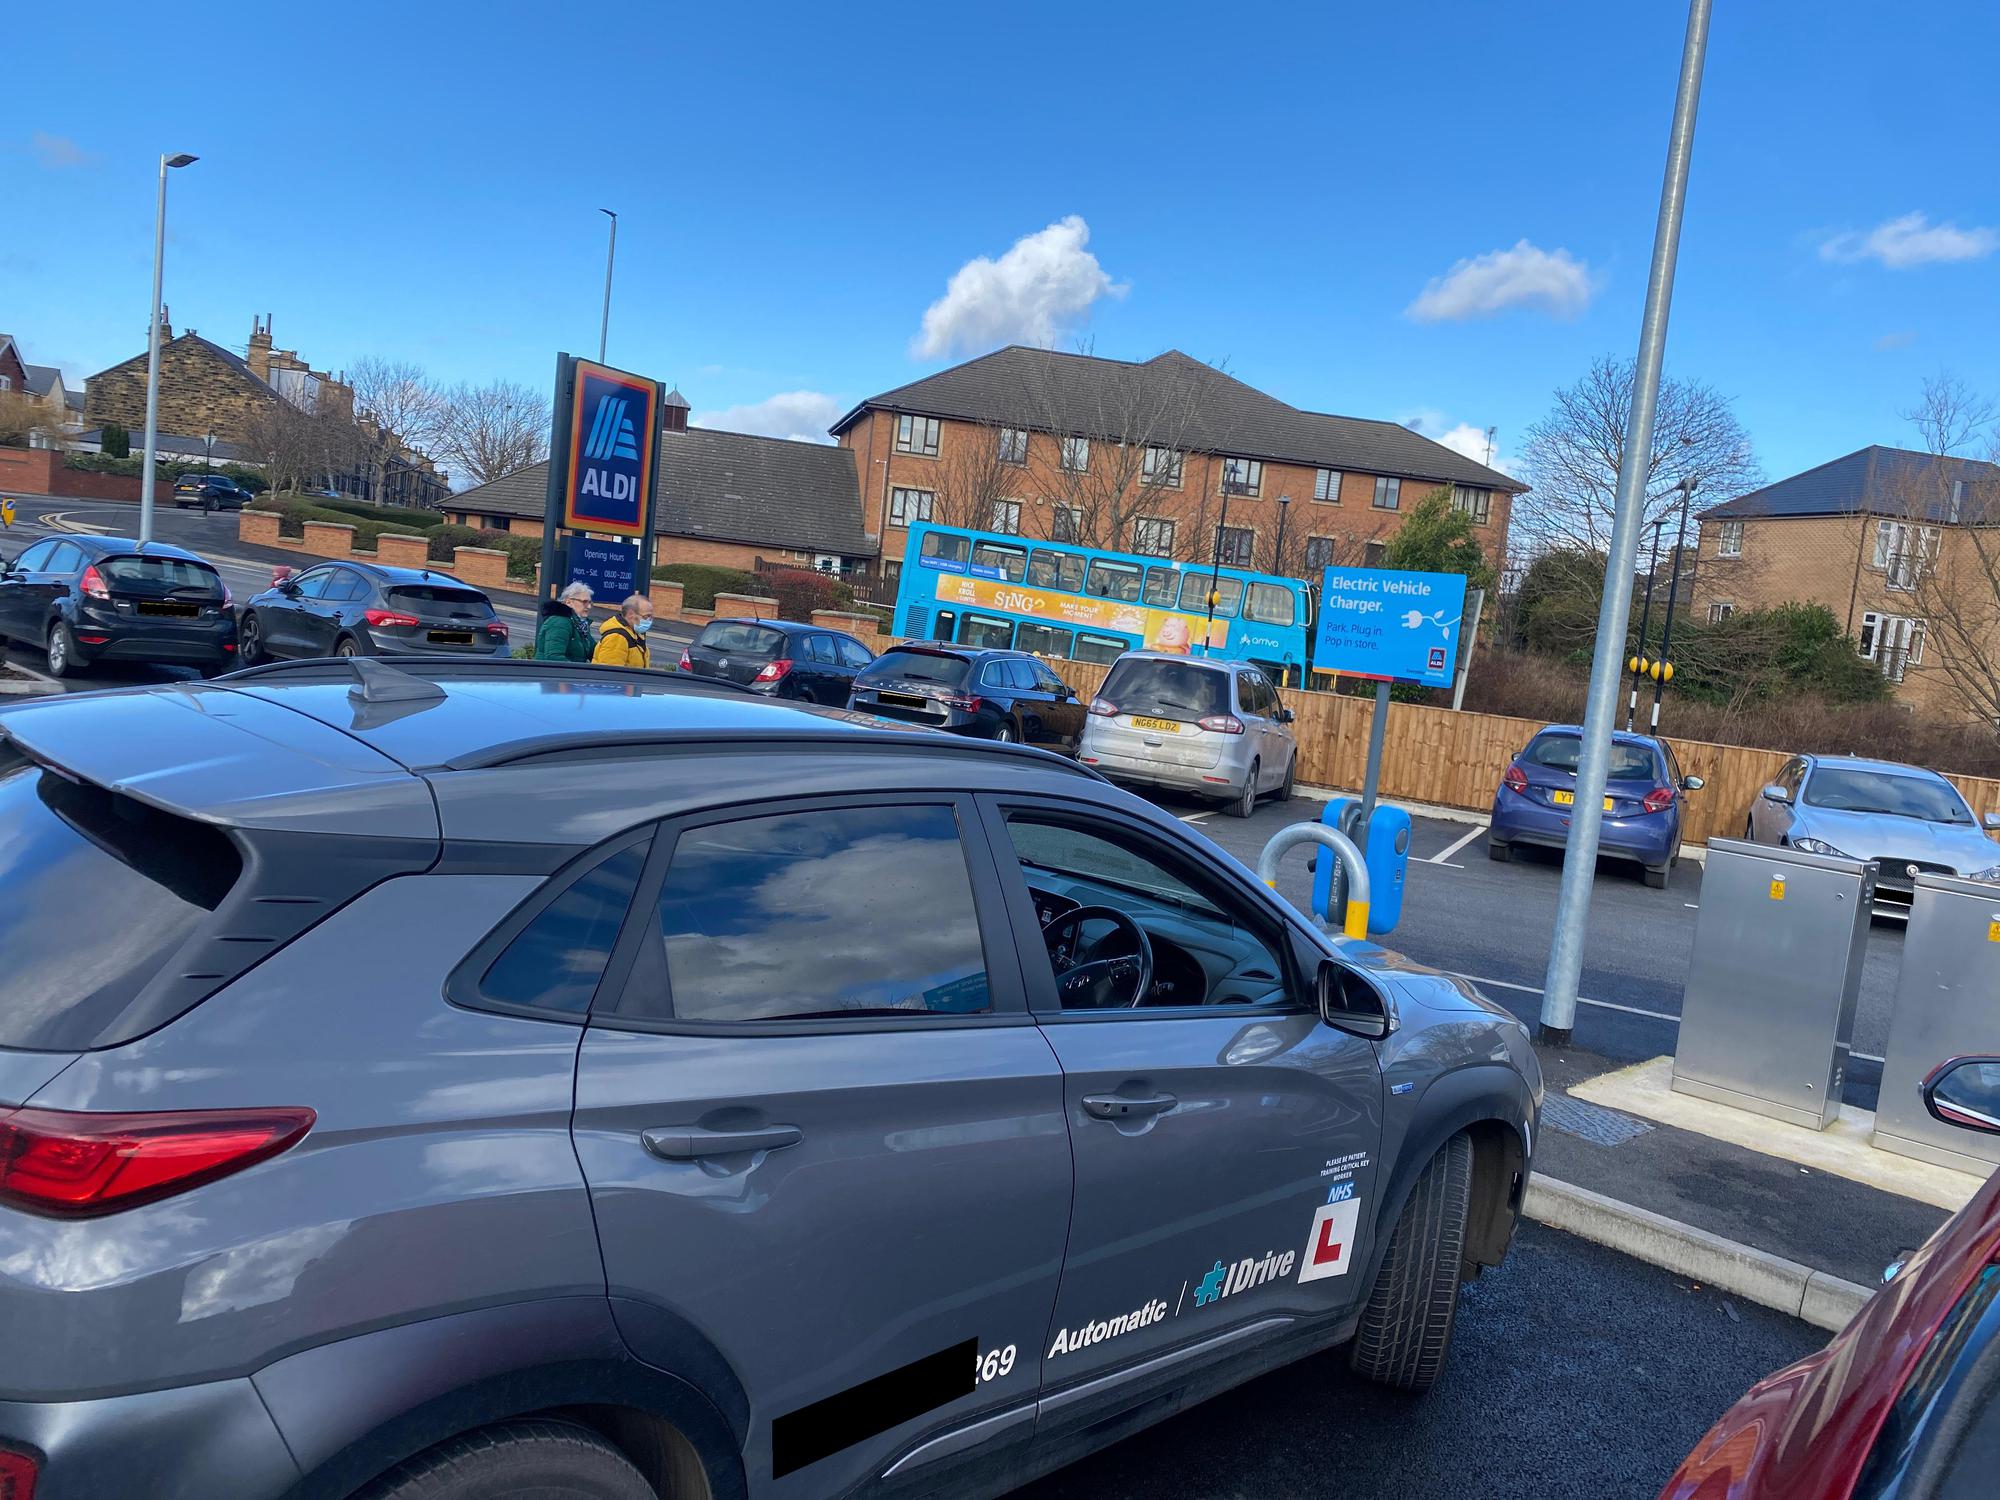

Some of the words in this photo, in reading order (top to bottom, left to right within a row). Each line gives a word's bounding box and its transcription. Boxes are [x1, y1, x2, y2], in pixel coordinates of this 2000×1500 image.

[581, 468, 637, 502] ALDI
[584, 549, 607, 561] Opening
[609, 553, 625, 561] Hours
[1332, 576, 1379, 592] Electric
[1382, 580, 1431, 596] Vehicle
[1060, 602, 1079, 611] MAKE
[1080, 604, 1099, 614] YOUR
[1329, 595, 1384, 614] Charger.
[1063, 609, 1094, 619] MOMENT
[1351, 624, 1371, 637] Plug
[1252, 637, 1279, 647] arriva
[1325, 636, 1342, 648] Pop
[1135, 718, 1158, 728] NG65
[1159, 721, 1177, 731] LDZ
[1326, 1157, 1341, 1167] PLEASE
[1342, 1155, 1348, 1163] BE
[1348, 1151, 1367, 1161] PATIENT
[1320, 1165, 1341, 1177] TRAINING
[1341, 1162, 1360, 1171] CRITICAL
[1333, 1171, 1352, 1181] WORKER
[1327, 1182, 1354, 1203] NHS
[1312, 1218, 1342, 1266] L
[1047, 1298, 1168, 1360] Automatic
[1221, 1250, 1296, 1298] IDrive
